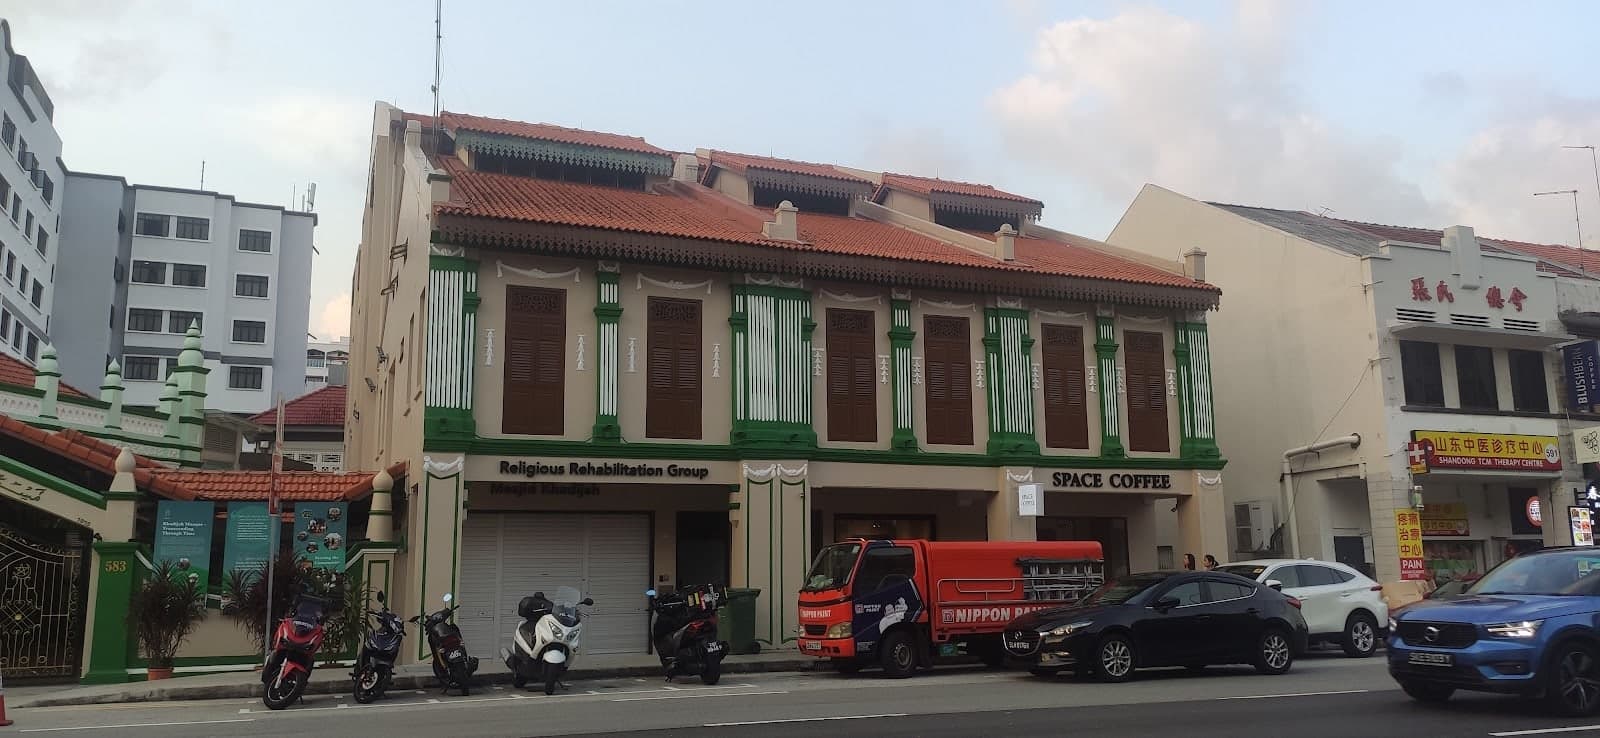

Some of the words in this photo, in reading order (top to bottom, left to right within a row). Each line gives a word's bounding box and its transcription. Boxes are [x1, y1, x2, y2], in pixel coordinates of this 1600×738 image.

[1435, 437, 1543, 455] 山东中医诊疗中心
[1546, 448, 1558, 458] 591
[1439, 456, 1476, 465] SHANDONG
[1494, 458, 1521, 466] THERAPY
[500, 460, 565, 478] Religious
[569, 462, 663, 477] Rehabilitation
[667, 464, 709, 480] Group
[1052, 472, 1103, 488] SPACE
[1109, 473, 1171, 489] COFFEE
[105, 561, 127, 572] 583
[1402, 560, 1422, 569] PAIN
[956, 608, 1010, 622] NIPPON
